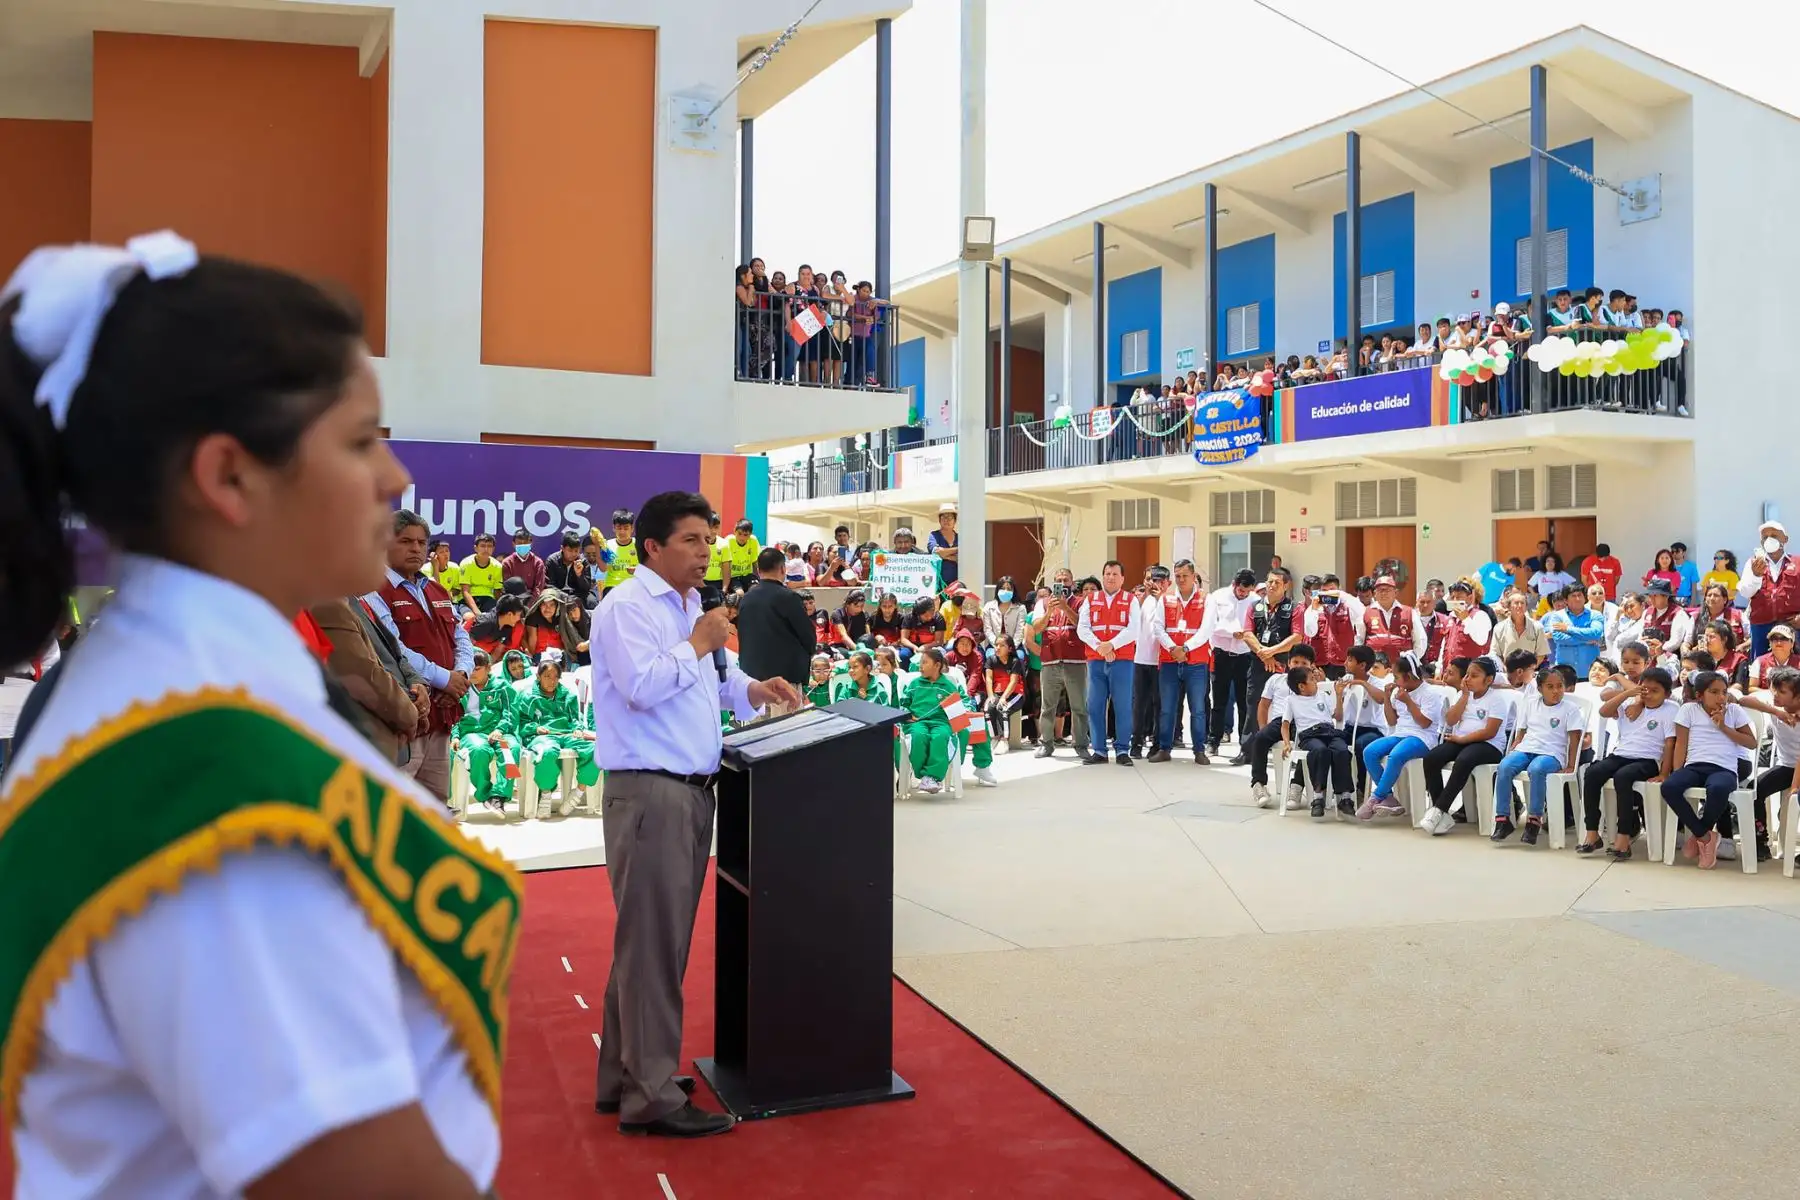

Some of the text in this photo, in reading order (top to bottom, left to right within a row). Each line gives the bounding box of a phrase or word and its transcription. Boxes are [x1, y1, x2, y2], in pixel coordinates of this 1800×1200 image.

[1311, 393, 1410, 419] Educación de calidad
[1210, 416, 1260, 434] CASTILLO
[887, 556, 929, 565] Bienvenido
